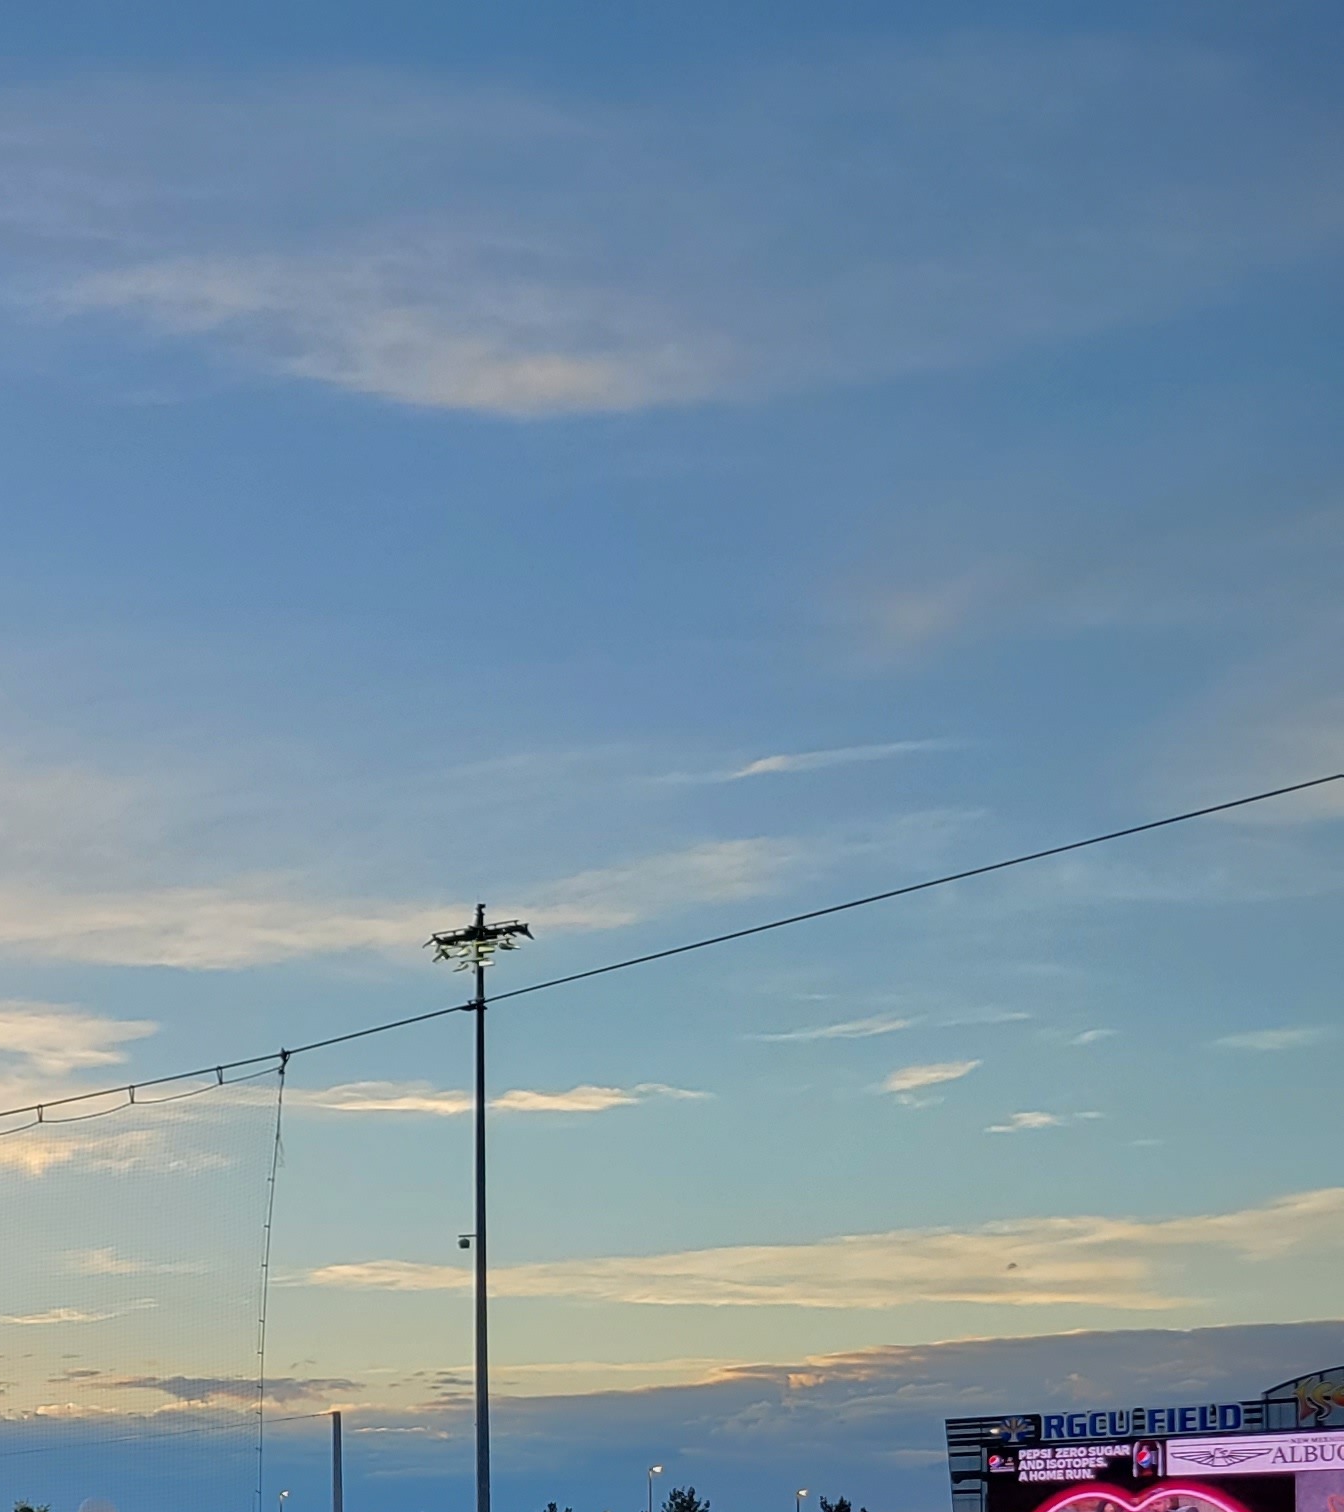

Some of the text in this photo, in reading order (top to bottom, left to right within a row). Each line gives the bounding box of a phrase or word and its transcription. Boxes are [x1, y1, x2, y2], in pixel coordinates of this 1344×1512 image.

[1043, 1404, 1243, 1440] RGCU FIELD
[1018, 1445, 1131, 1460] PEPSI ZERO SUGAR
[1018, 1457, 1108, 1471] AND ISOTOPES.
[1018, 1468, 1095, 1481] A HOME RUN.
